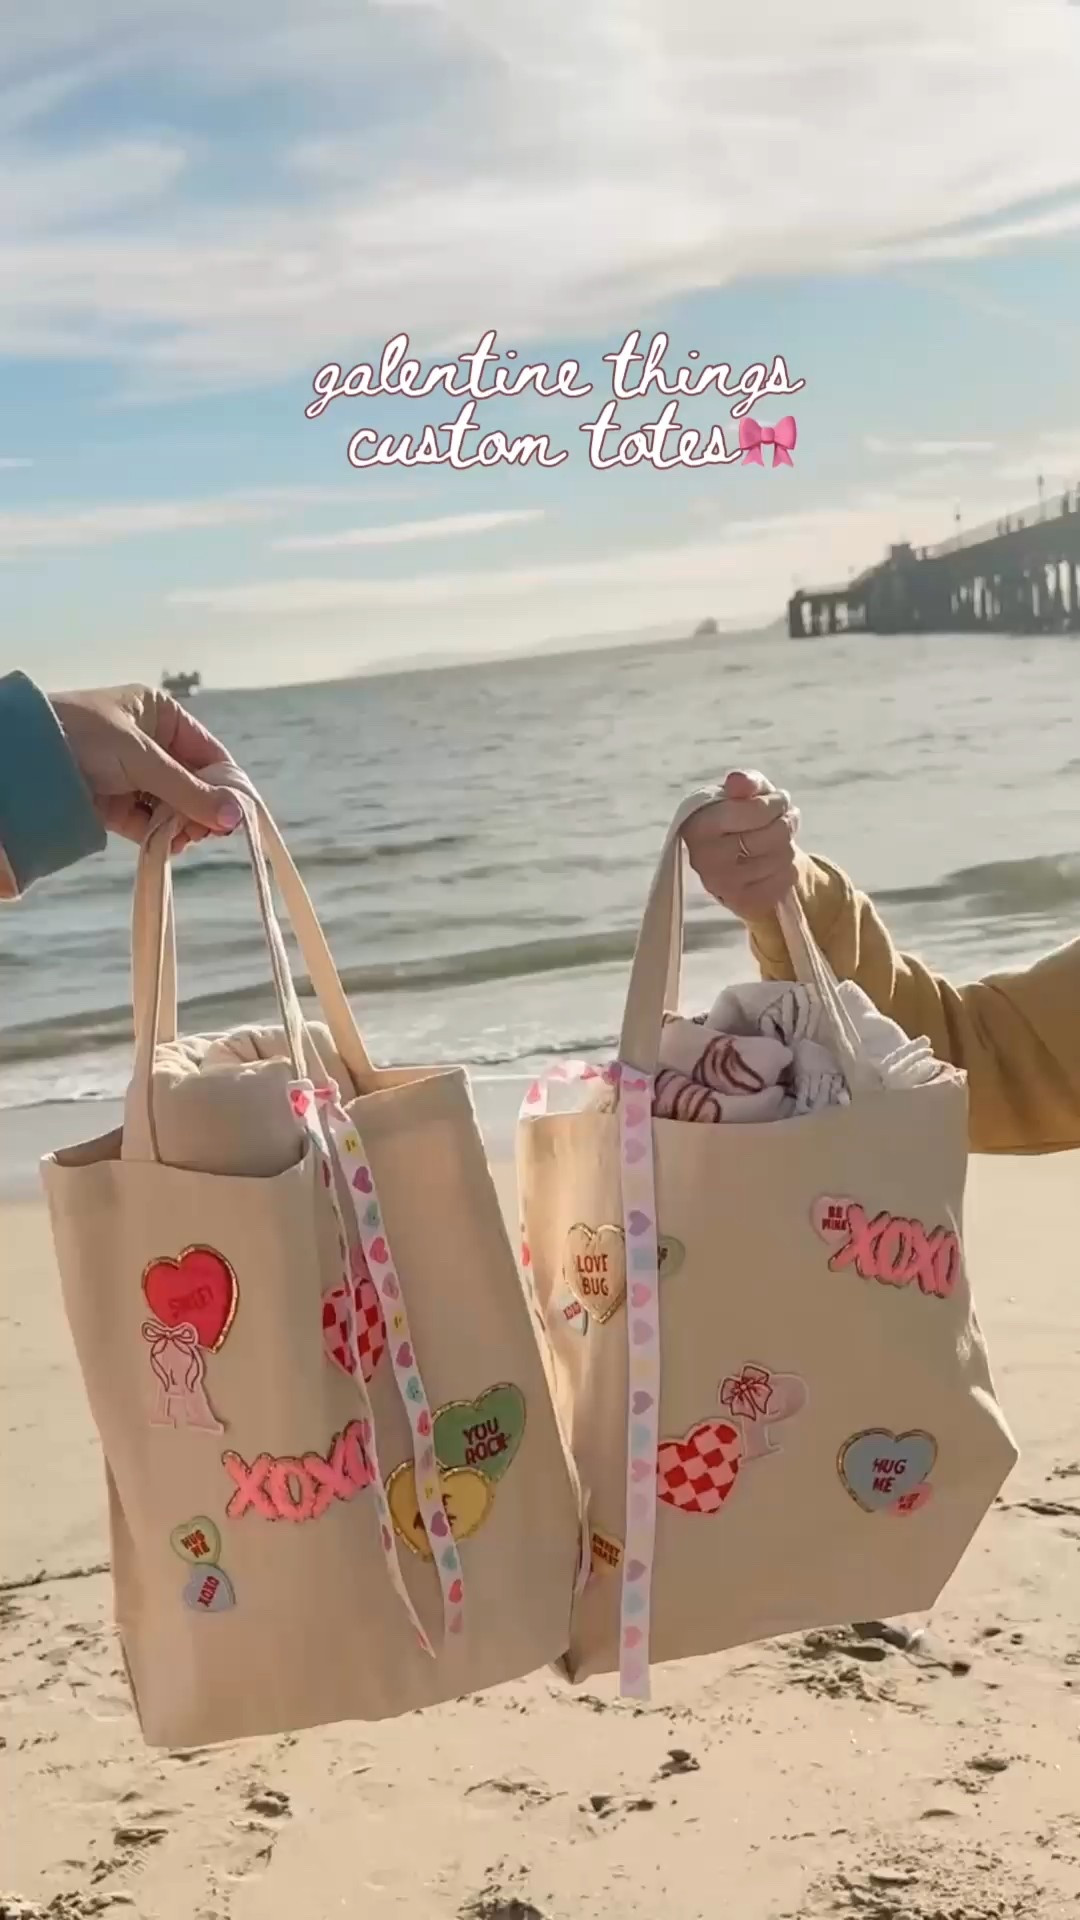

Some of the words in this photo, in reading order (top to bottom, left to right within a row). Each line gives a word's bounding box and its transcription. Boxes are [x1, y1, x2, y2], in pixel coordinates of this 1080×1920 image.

[828, 1203, 960, 1298] XOXO
[576, 1254, 609, 1273] LOVE
[581, 1277, 609, 1296] BUG
[463, 1417, 500, 1444] YOU
[465, 1432, 509, 1465] ROCK
[221, 1419, 374, 1522] XOXO
[872, 1458, 908, 1475] HUG
[872, 1476, 896, 1493] ME
